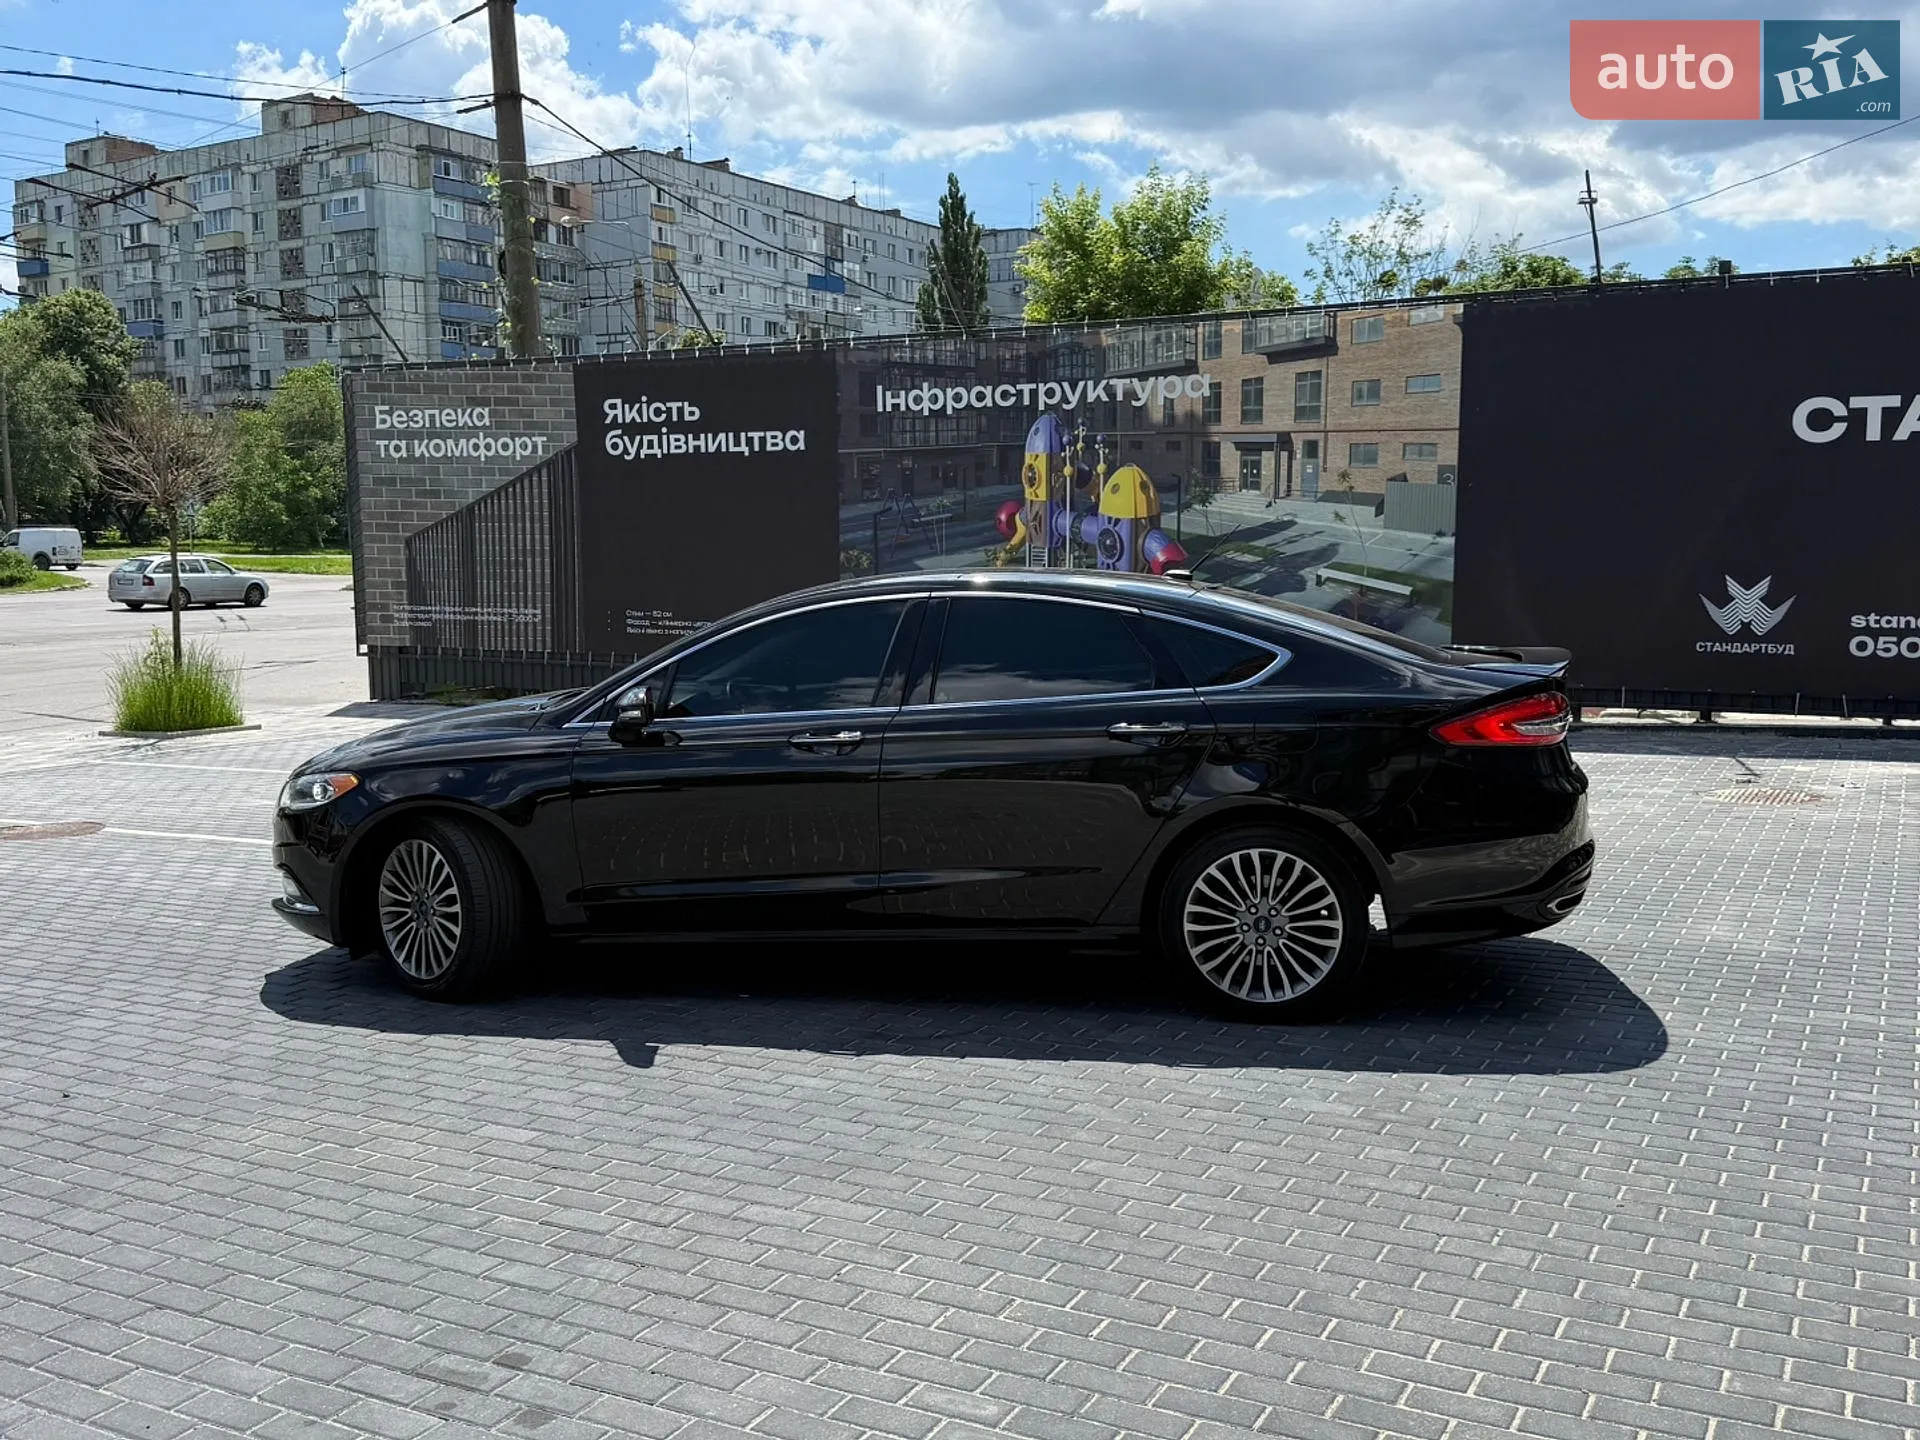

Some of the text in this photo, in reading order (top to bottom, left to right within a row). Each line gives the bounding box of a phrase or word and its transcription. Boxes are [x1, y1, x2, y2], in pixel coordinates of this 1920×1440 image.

[875, 373, 1211, 415] Інфраструктура
[374, 405, 491, 429] Безпека
[603, 395, 700, 424] Якість
[375, 432, 548, 461] та комфорт
[605, 427, 806, 460] будівництва
[1850, 612, 1920, 629] stan
[1696, 641, 1795, 655] СТАНДАРТБУД
[1849, 635, 1920, 658] 050
